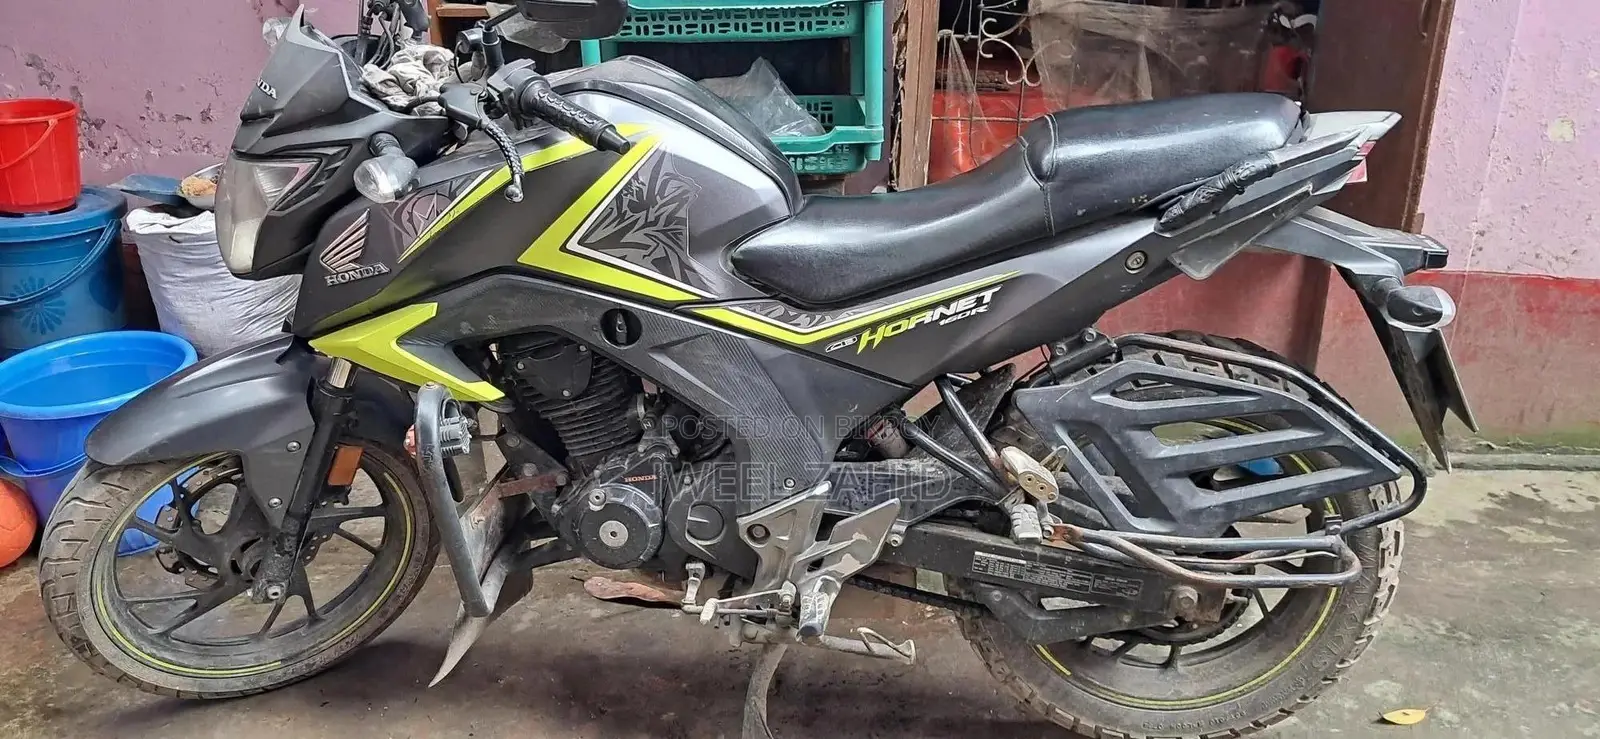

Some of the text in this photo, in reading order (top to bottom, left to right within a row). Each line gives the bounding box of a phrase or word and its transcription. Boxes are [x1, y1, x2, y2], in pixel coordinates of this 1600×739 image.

[257, 77, 277, 99] NDA
[324, 262, 391, 286] HONDA
[825, 285, 1002, 354] CB HORNET
[624, 474, 657, 483] HONDA
